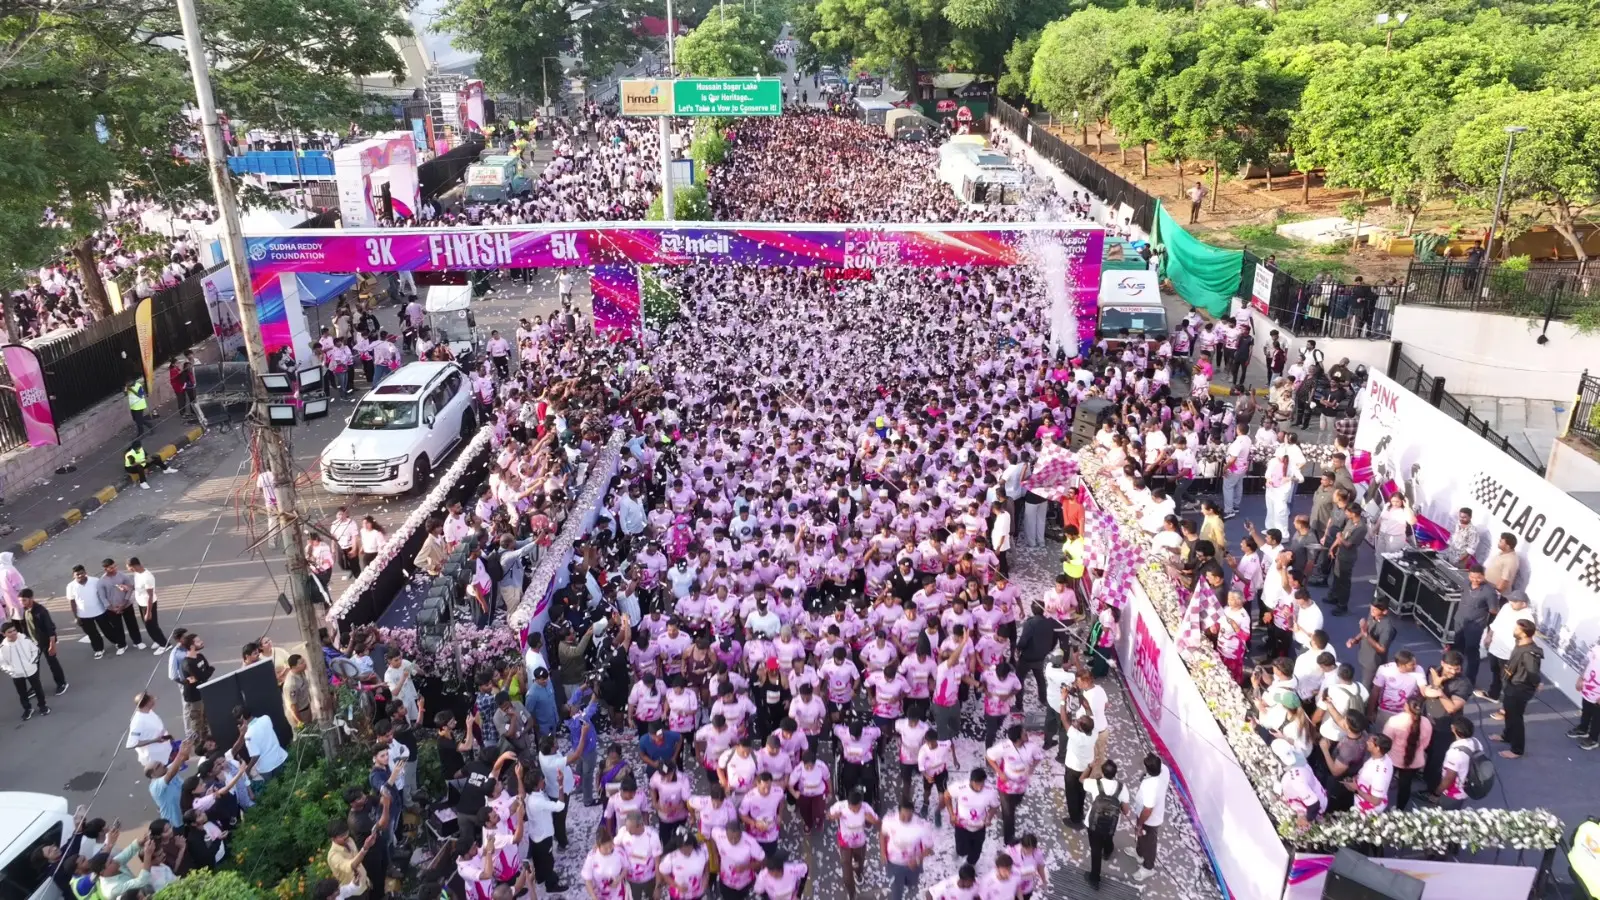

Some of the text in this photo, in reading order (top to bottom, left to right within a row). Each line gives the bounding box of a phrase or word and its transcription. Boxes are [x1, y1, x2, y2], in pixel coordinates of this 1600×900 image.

[723, 83, 741, 91] Sagar
[627, 95, 658, 104] hmda
[708, 94, 719, 102] Our
[845, 228, 885, 241] PINK
[269, 243, 297, 251] SUDHA
[365, 232, 580, 267] 3K FINISH 5K
[685, 234, 729, 254] meil
[844, 241, 898, 255] POWER
[271, 252, 325, 260] FOUNDATION
[843, 254, 877, 269] RUN
[1117, 282, 1146, 290] SVS
[1370, 379, 1400, 415] PINK
[1492, 489, 1592, 573] FLAG OFF
